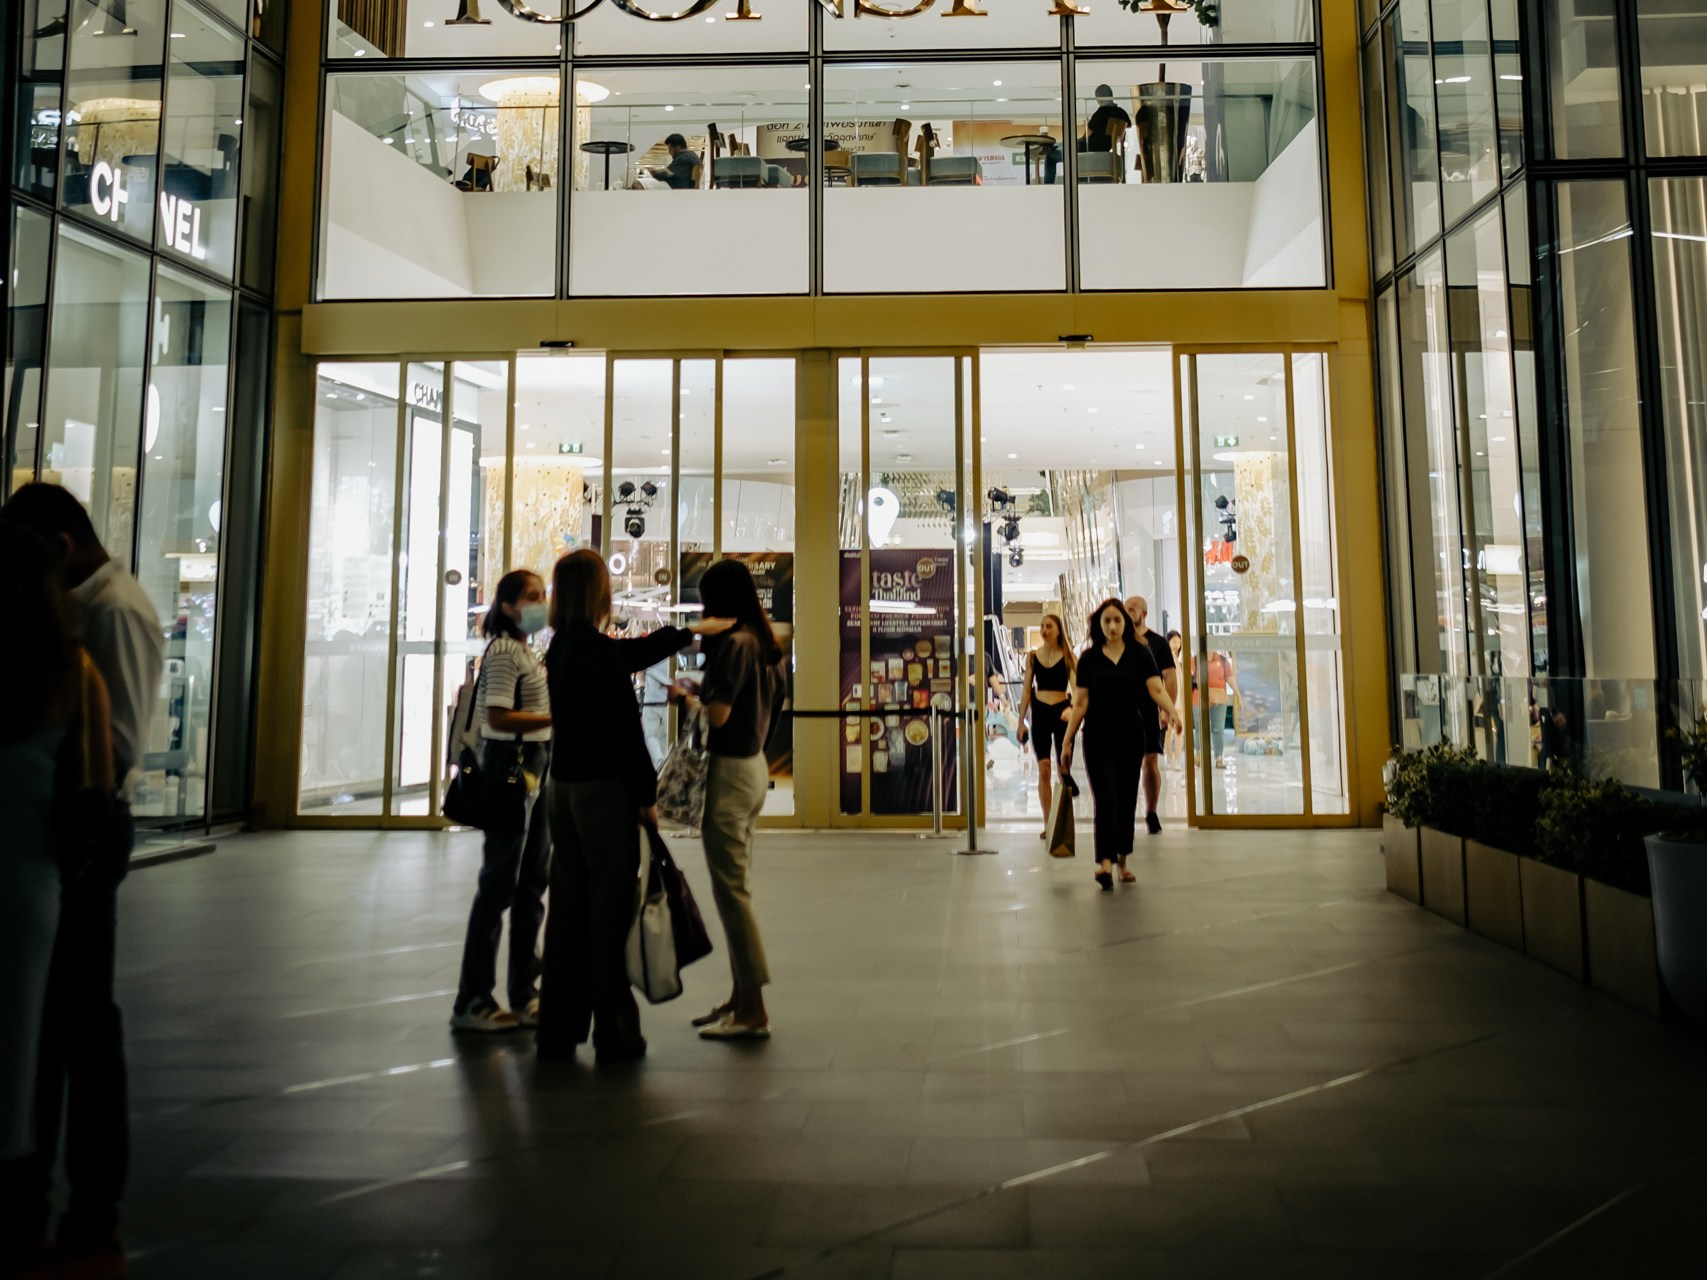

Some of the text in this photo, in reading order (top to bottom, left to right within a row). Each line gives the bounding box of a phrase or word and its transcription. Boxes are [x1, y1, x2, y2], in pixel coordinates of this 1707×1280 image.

[90, 161, 206, 260] CHNEL
[919, 564, 934, 572] OUT
[872, 570, 922, 588] taste
